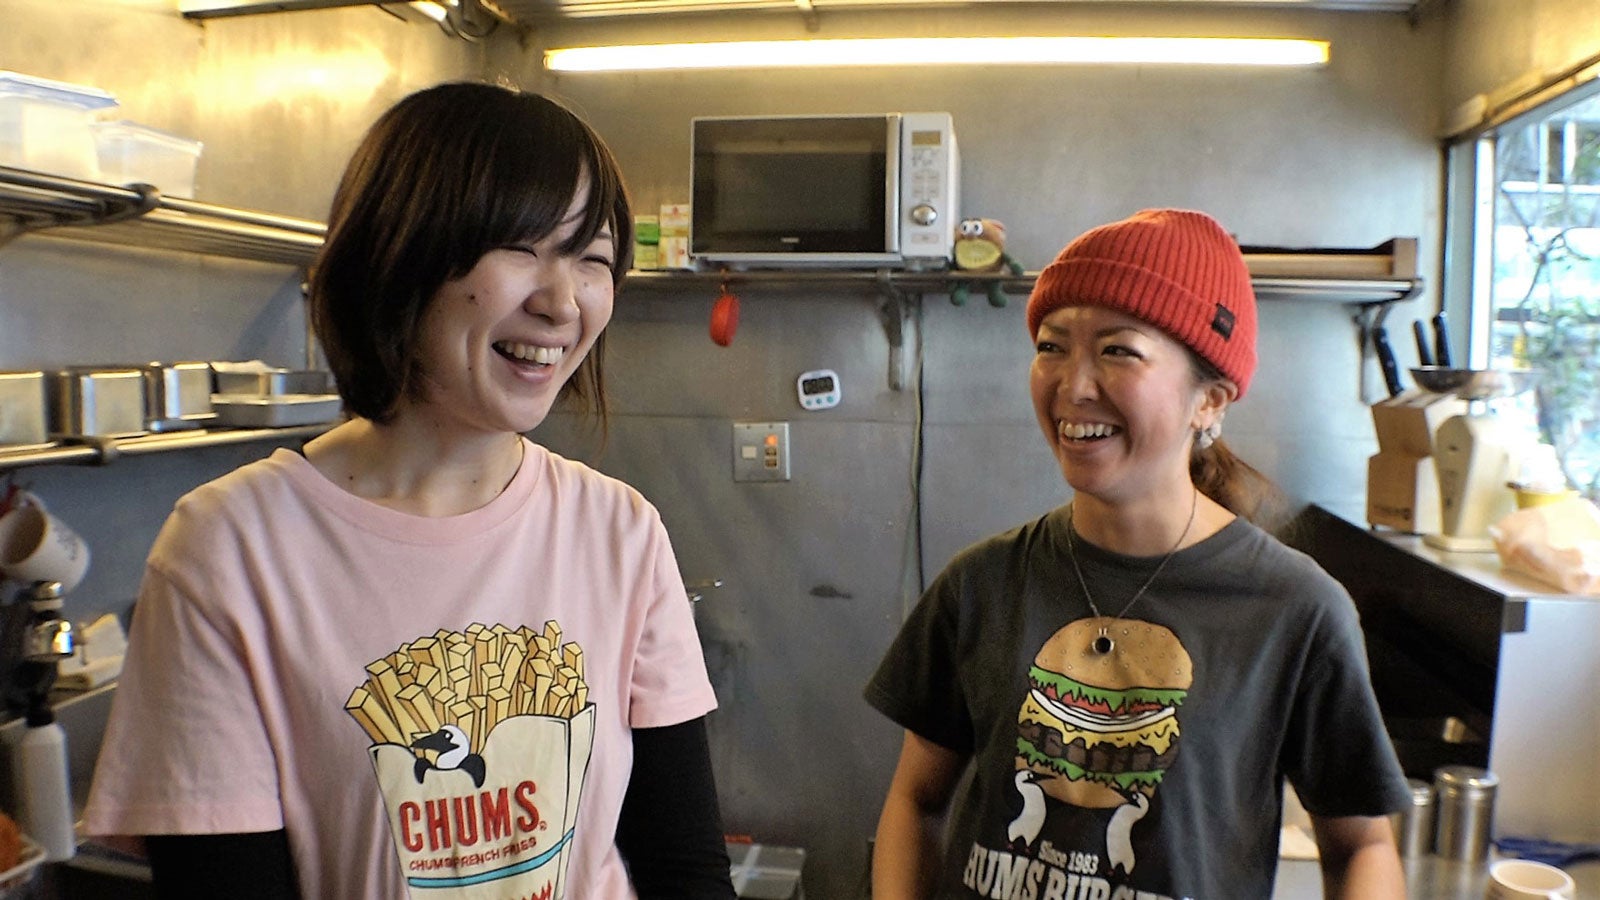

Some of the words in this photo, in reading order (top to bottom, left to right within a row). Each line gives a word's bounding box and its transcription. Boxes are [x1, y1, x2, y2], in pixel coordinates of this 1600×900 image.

[400, 780, 539, 853] CHUMS
[455, 849, 500, 868] FRENCH
[503, 836, 537, 857] FRIES
[963, 841, 1046, 900] HUMS
[1067, 851, 1099, 875] 1983
